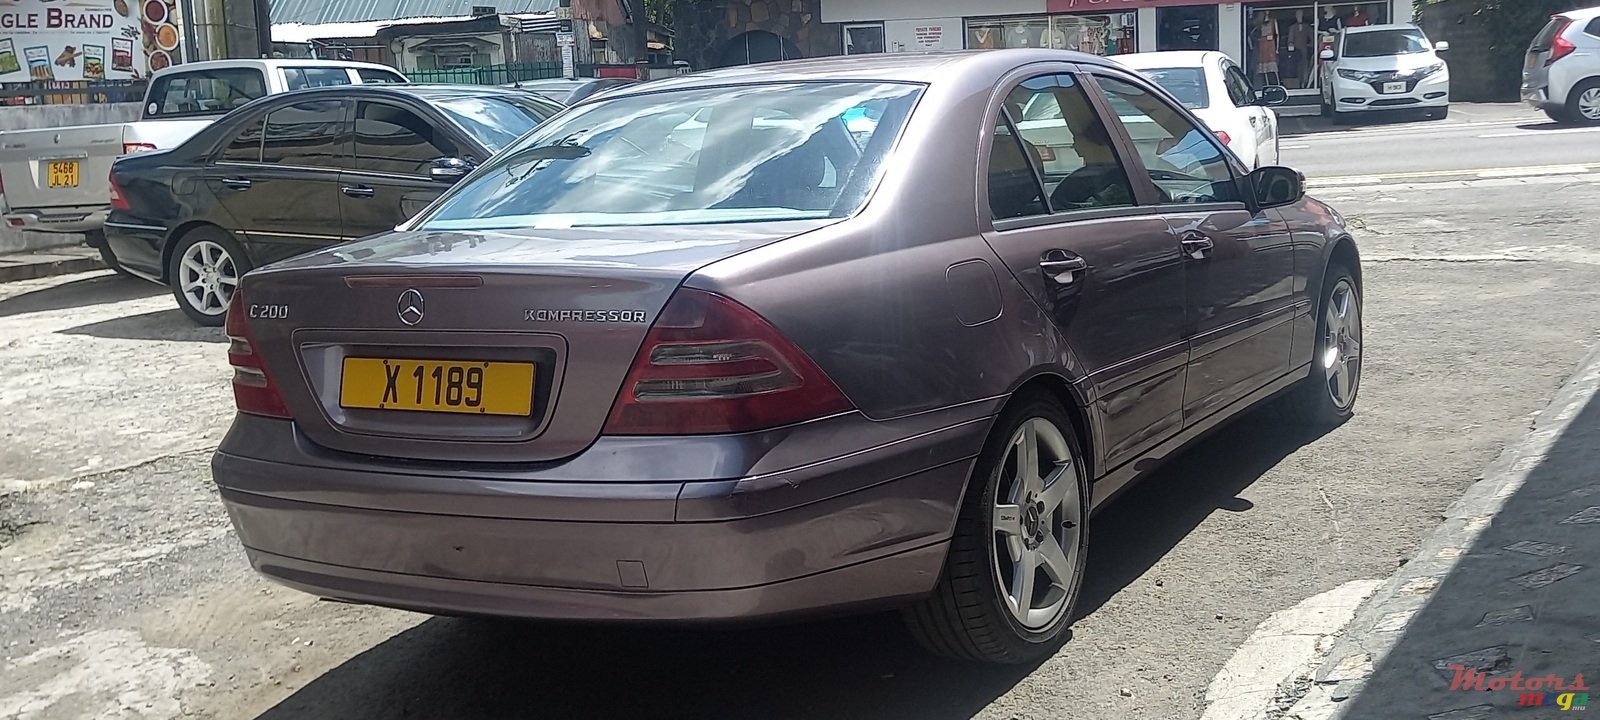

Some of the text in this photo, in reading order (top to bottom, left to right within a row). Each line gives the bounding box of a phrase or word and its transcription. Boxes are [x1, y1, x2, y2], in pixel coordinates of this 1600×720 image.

[0, 13, 38, 28] GLE
[53, 163, 74, 174] 5468
[52, 175, 74, 186] JL 21
[260, 305, 289, 319] 200
[524, 309, 646, 322] KOMPRESSOR
[383, 365, 484, 407] X 1189
